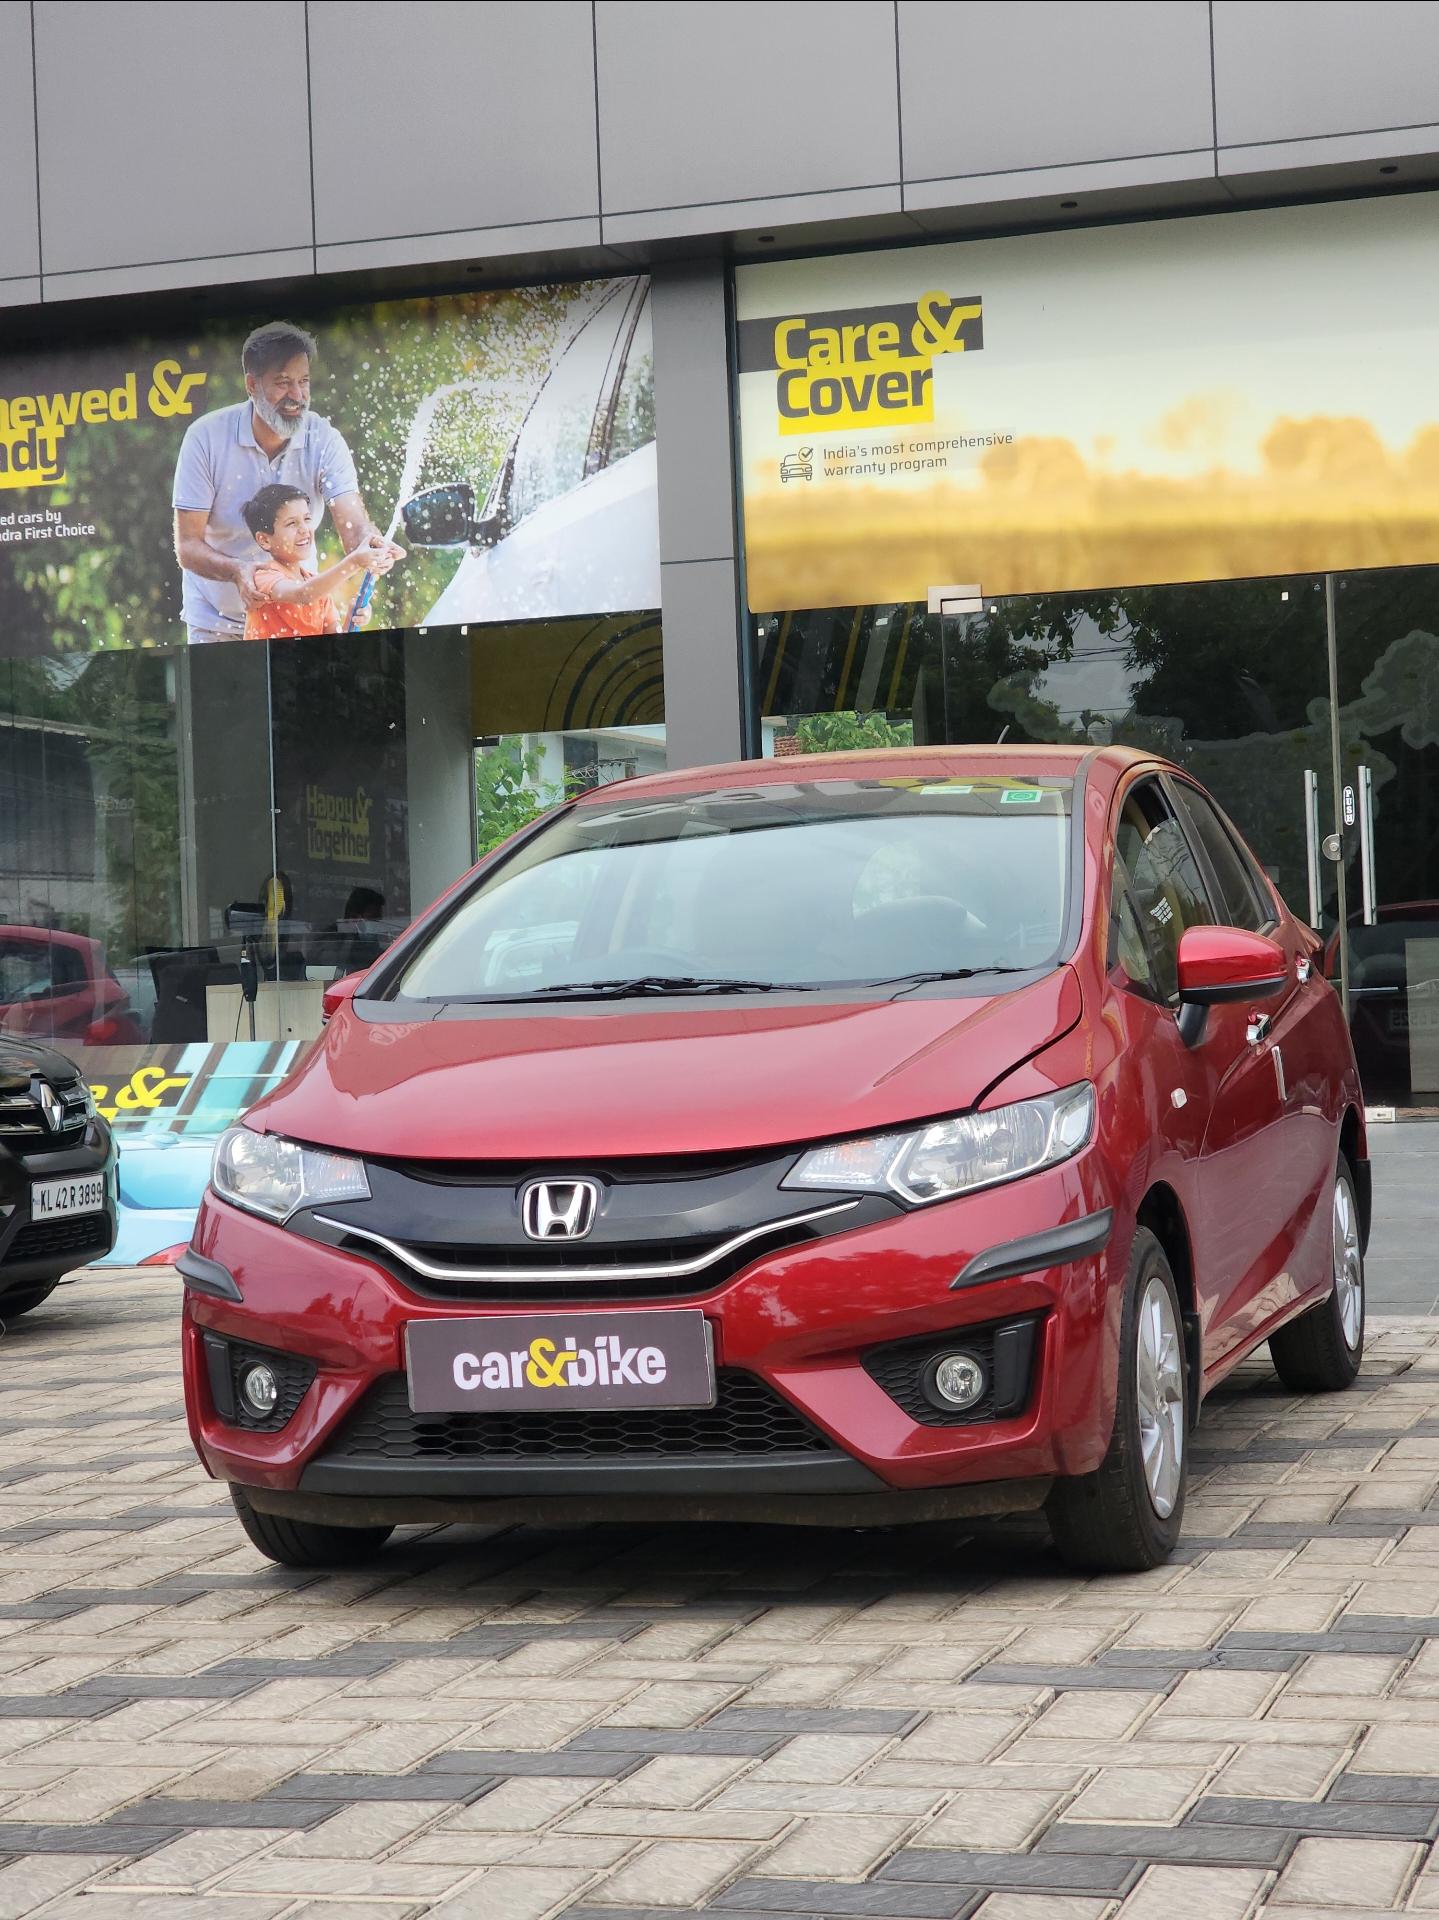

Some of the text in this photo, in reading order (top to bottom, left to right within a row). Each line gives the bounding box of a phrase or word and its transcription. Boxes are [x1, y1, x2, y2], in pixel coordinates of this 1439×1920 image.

[774, 290, 982, 370] Care &
[148, 359, 207, 418] &
[776, 367, 933, 419] Cover
[823, 432, 1013, 461] India's most comprehensive
[823, 457, 947, 477] warranty program
[17, 513, 43, 525] cars
[45, 509, 62, 524] by
[24, 526, 53, 540] First
[55, 522, 96, 537] Choice
[306, 784, 352, 823] Happy
[1345, 789, 1353, 822] PUSH
[307, 823, 371, 859] Together
[115, 1066, 191, 1109] &
[453, 1335, 667, 1391] car&bike
